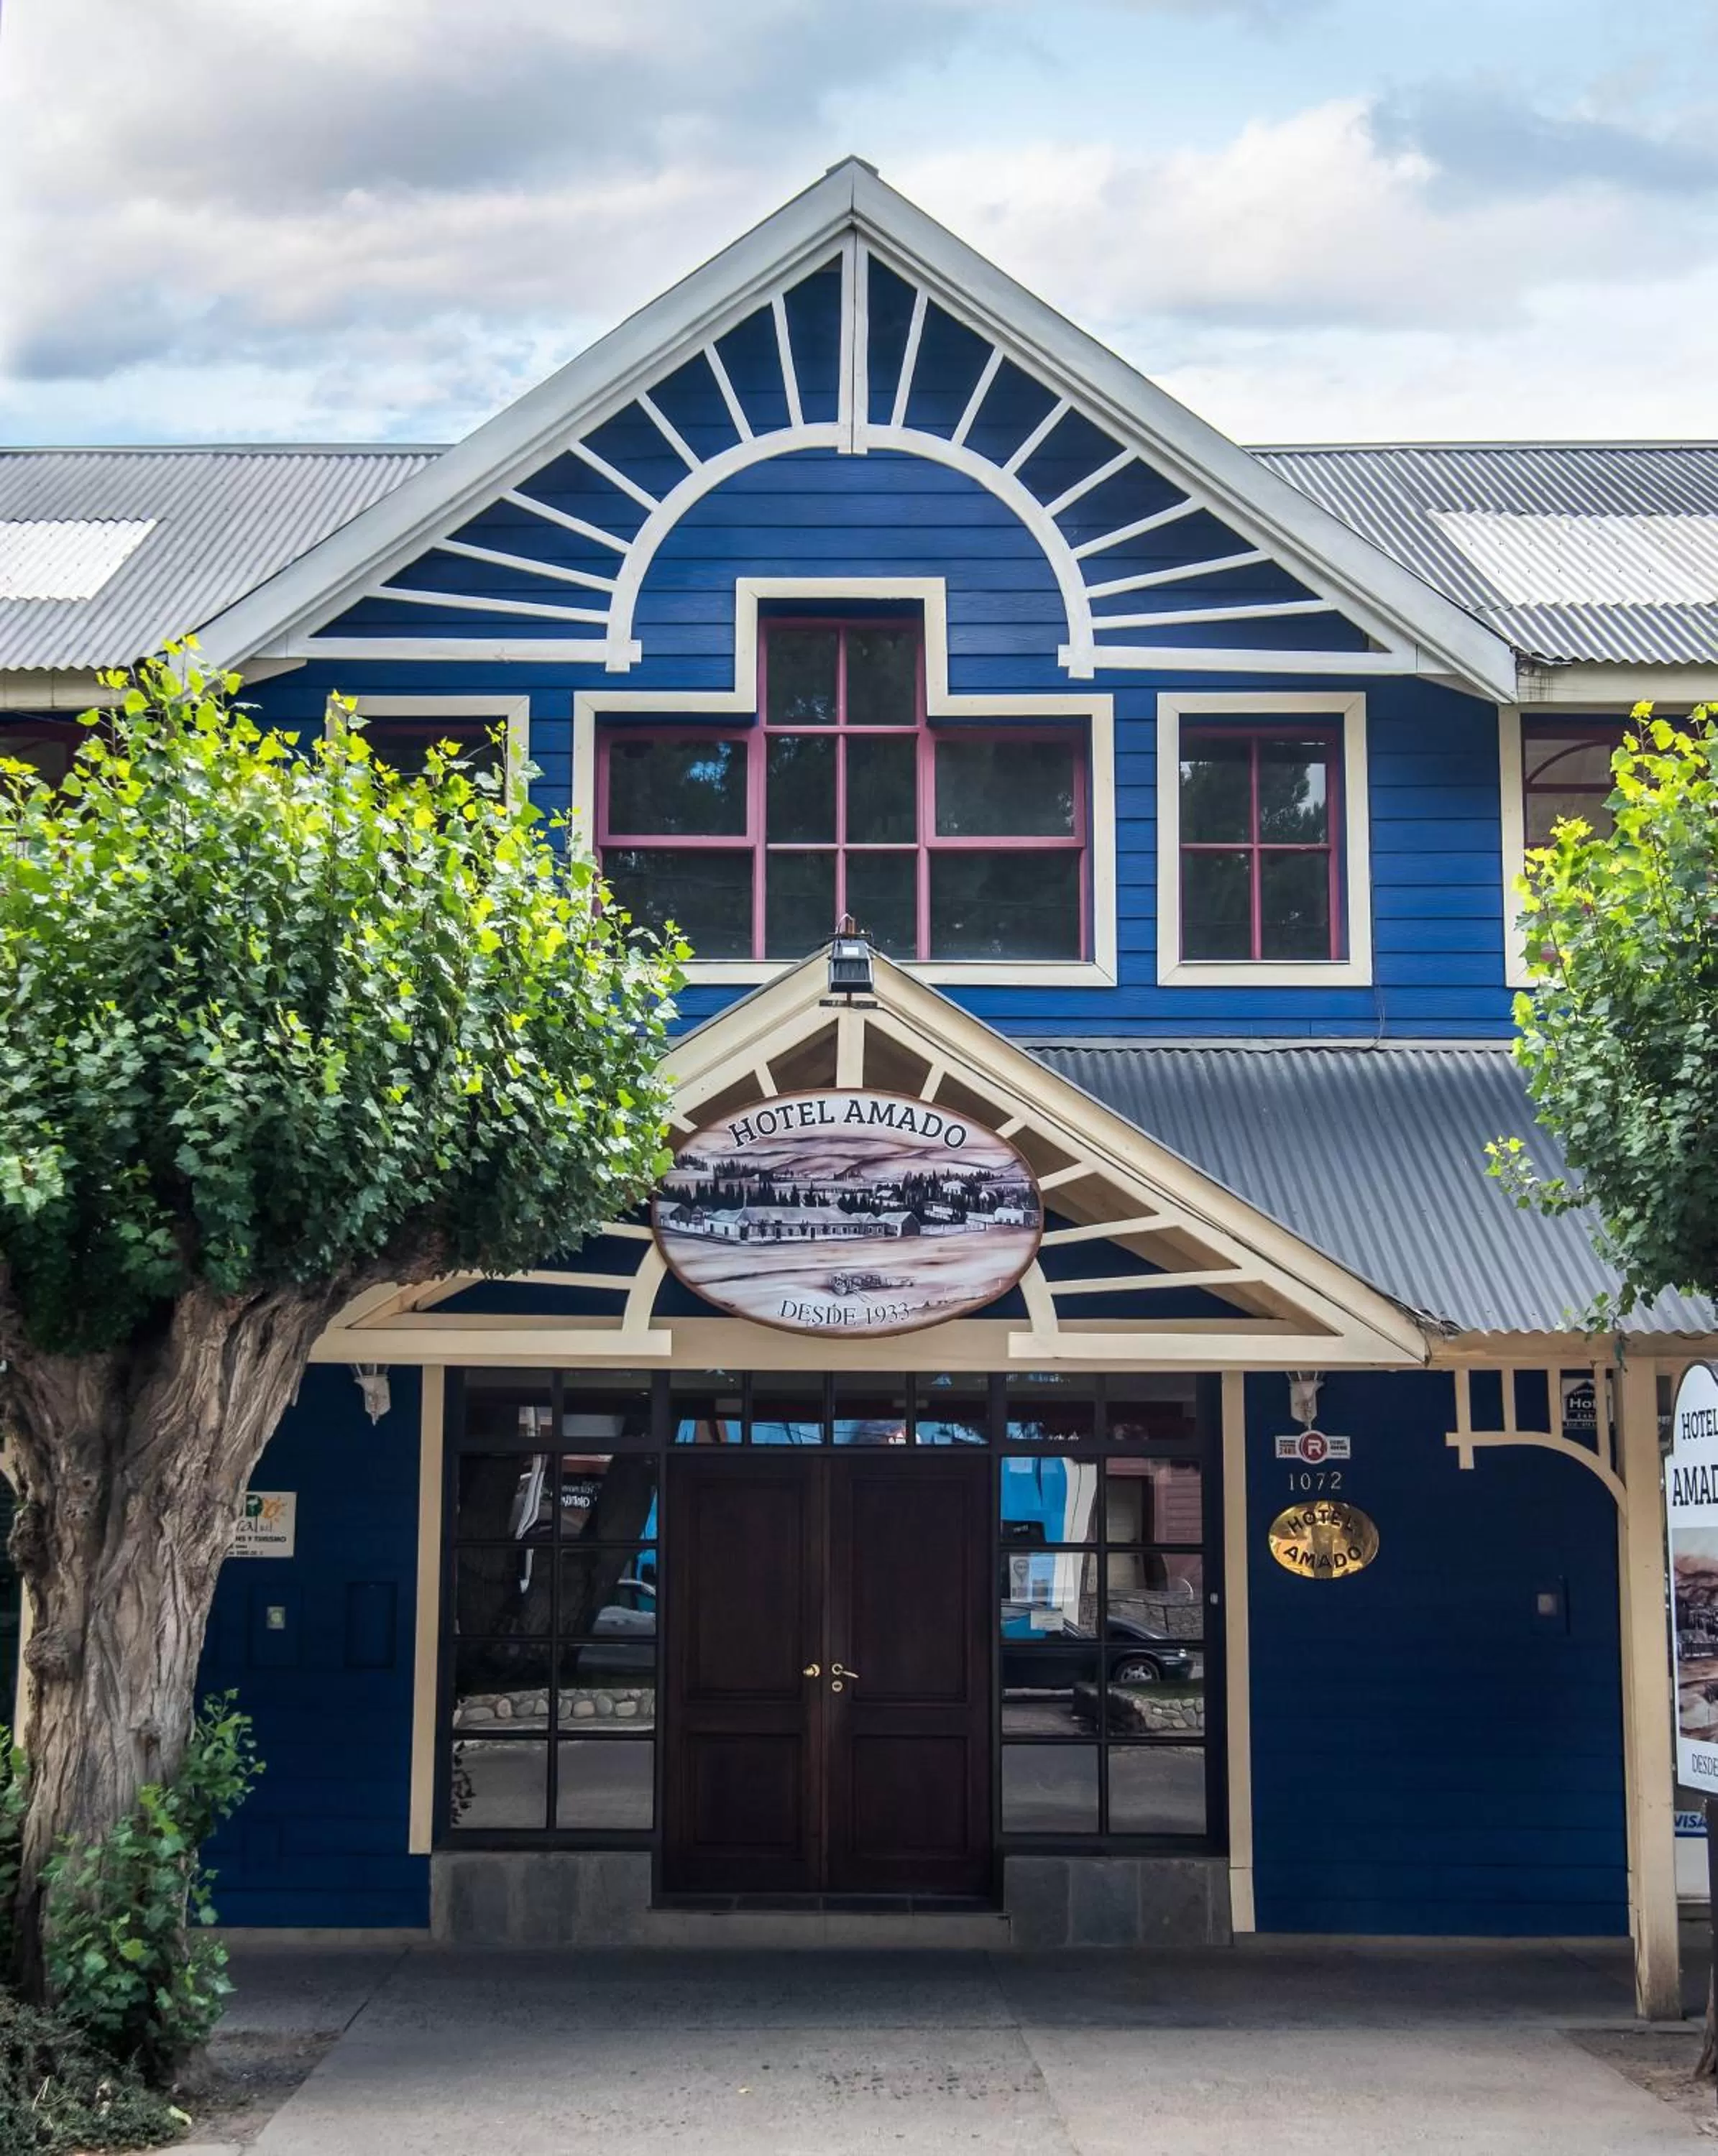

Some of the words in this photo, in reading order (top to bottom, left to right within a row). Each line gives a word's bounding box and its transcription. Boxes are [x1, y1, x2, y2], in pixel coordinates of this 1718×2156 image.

[728, 1100, 835, 1148] HOTEL
[843, 1099, 967, 1148] AMADO
[781, 1300, 857, 1325] DESDE
[865, 1302, 910, 1325] 1933
[1681, 1408, 1718, 1440] HOTEL
[1289, 1471, 1342, 1491] 1072
[1287, 1509, 1354, 1533] HOTEL
[1283, 1546, 1362, 1569] AMADO
[1691, 1754, 1718, 1777] DESDE
